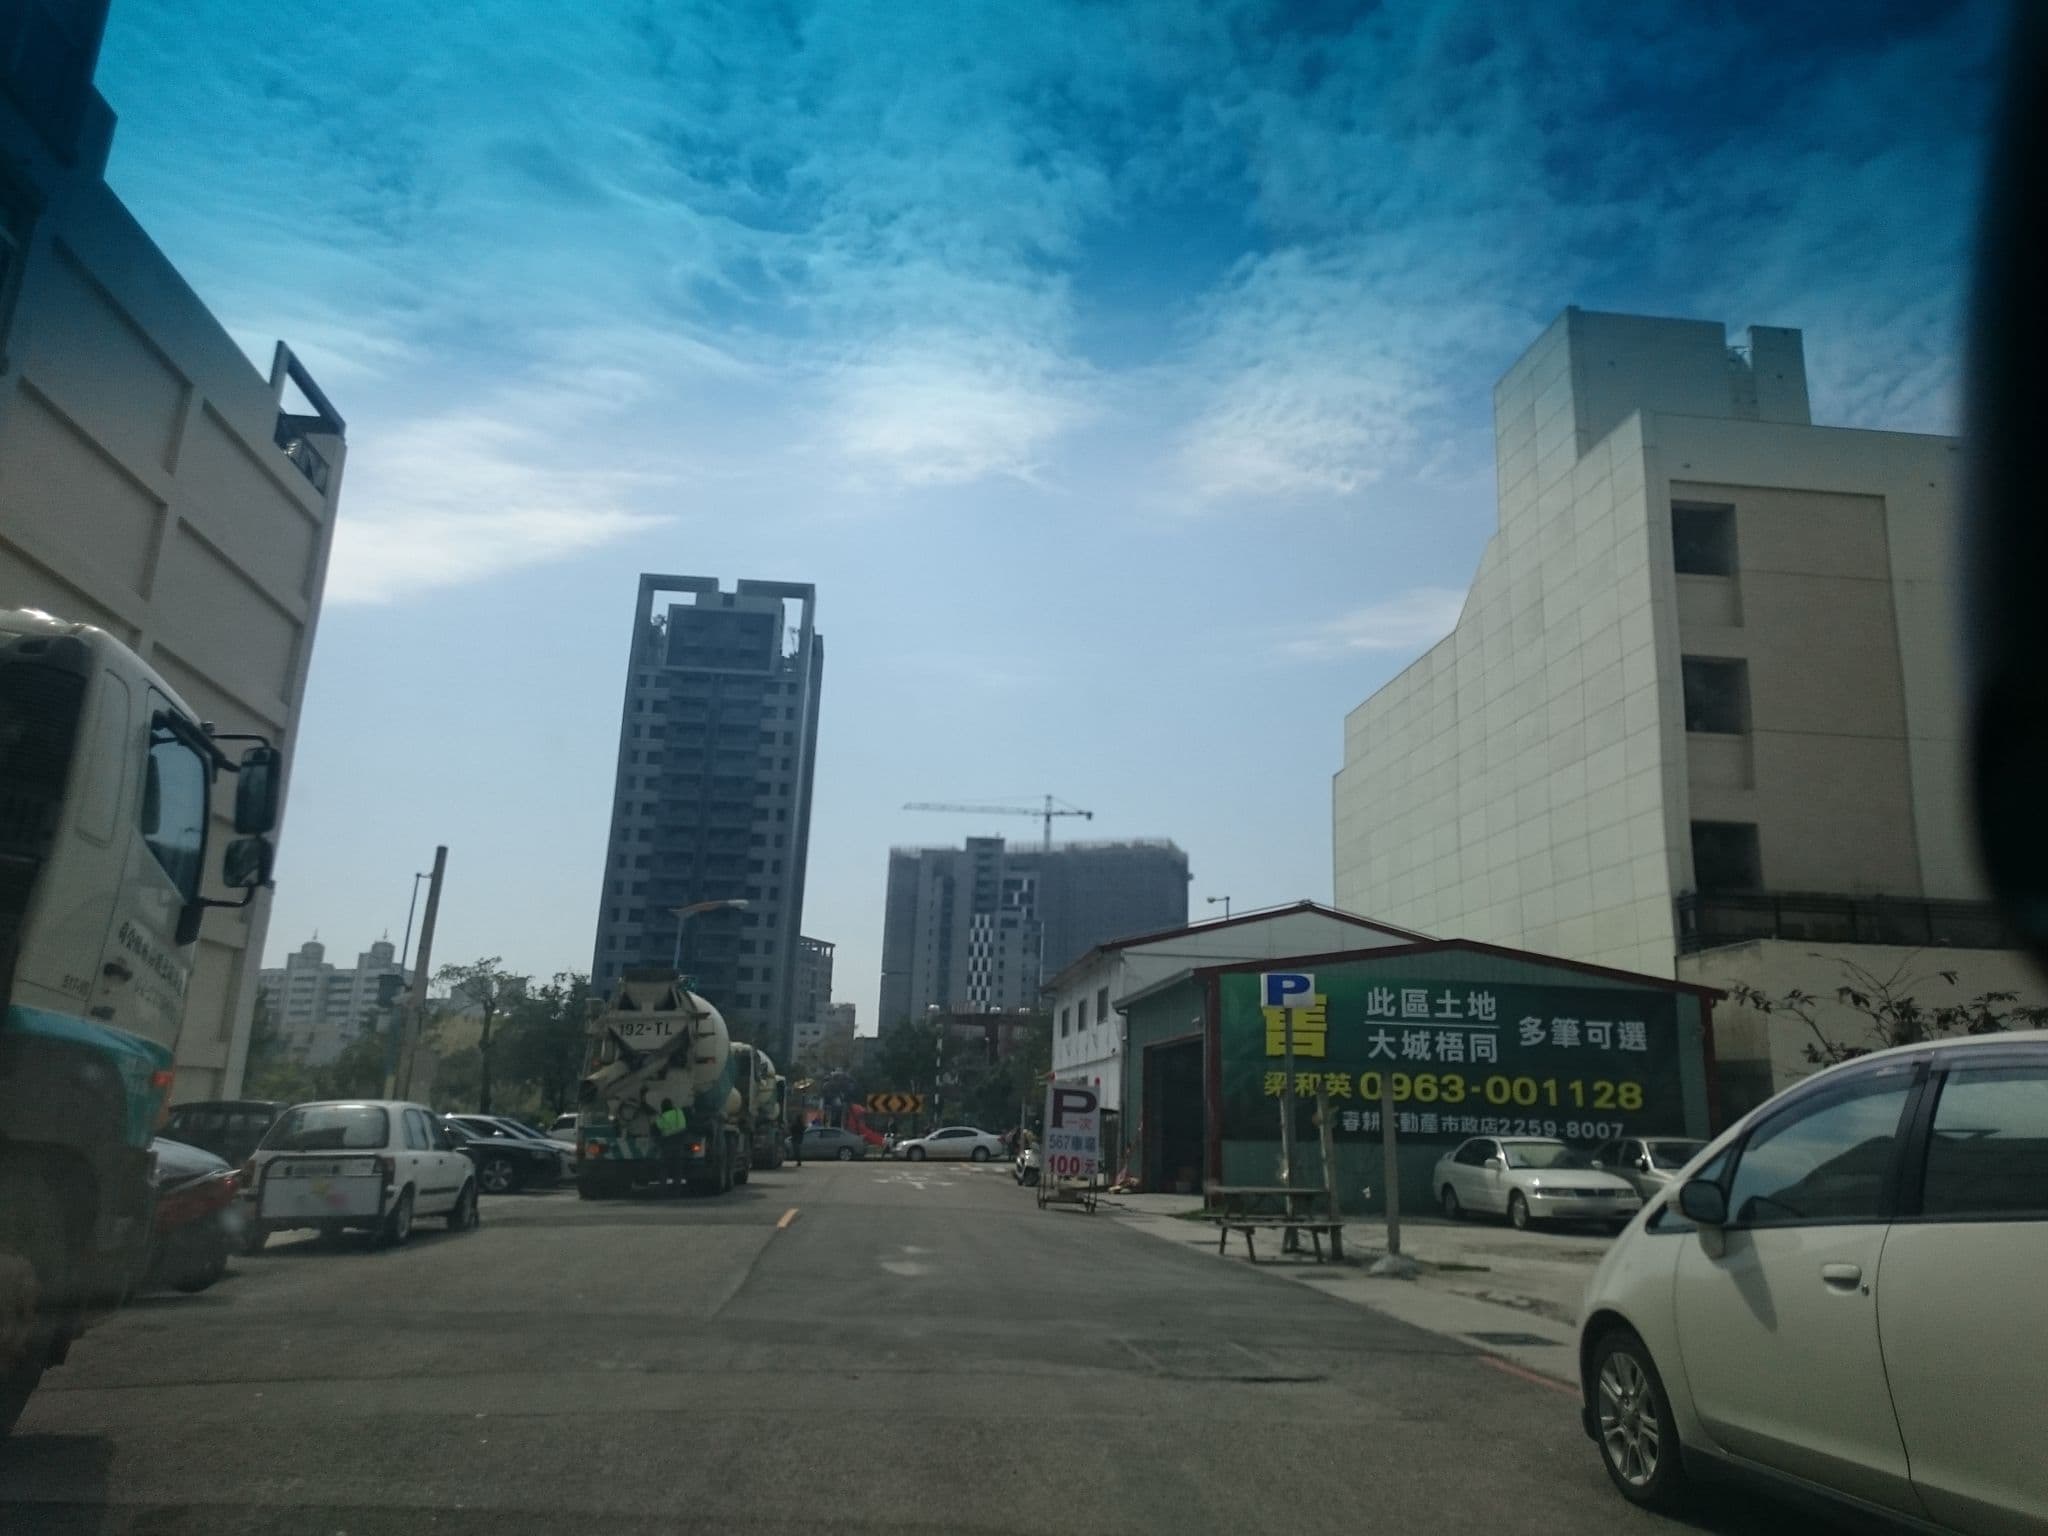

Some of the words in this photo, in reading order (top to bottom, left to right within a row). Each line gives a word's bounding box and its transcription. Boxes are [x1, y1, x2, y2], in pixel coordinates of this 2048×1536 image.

[1267, 974, 1310, 1006] P
[1367, 985, 1497, 1021] 此區土地
[1367, 1028, 1498, 1064] 大城梧同
[1518, 1016, 1648, 1051] 多筆可選
[1051, 1088, 1098, 1128] P
[1359, 1072, 1645, 1112] 0963-001128
